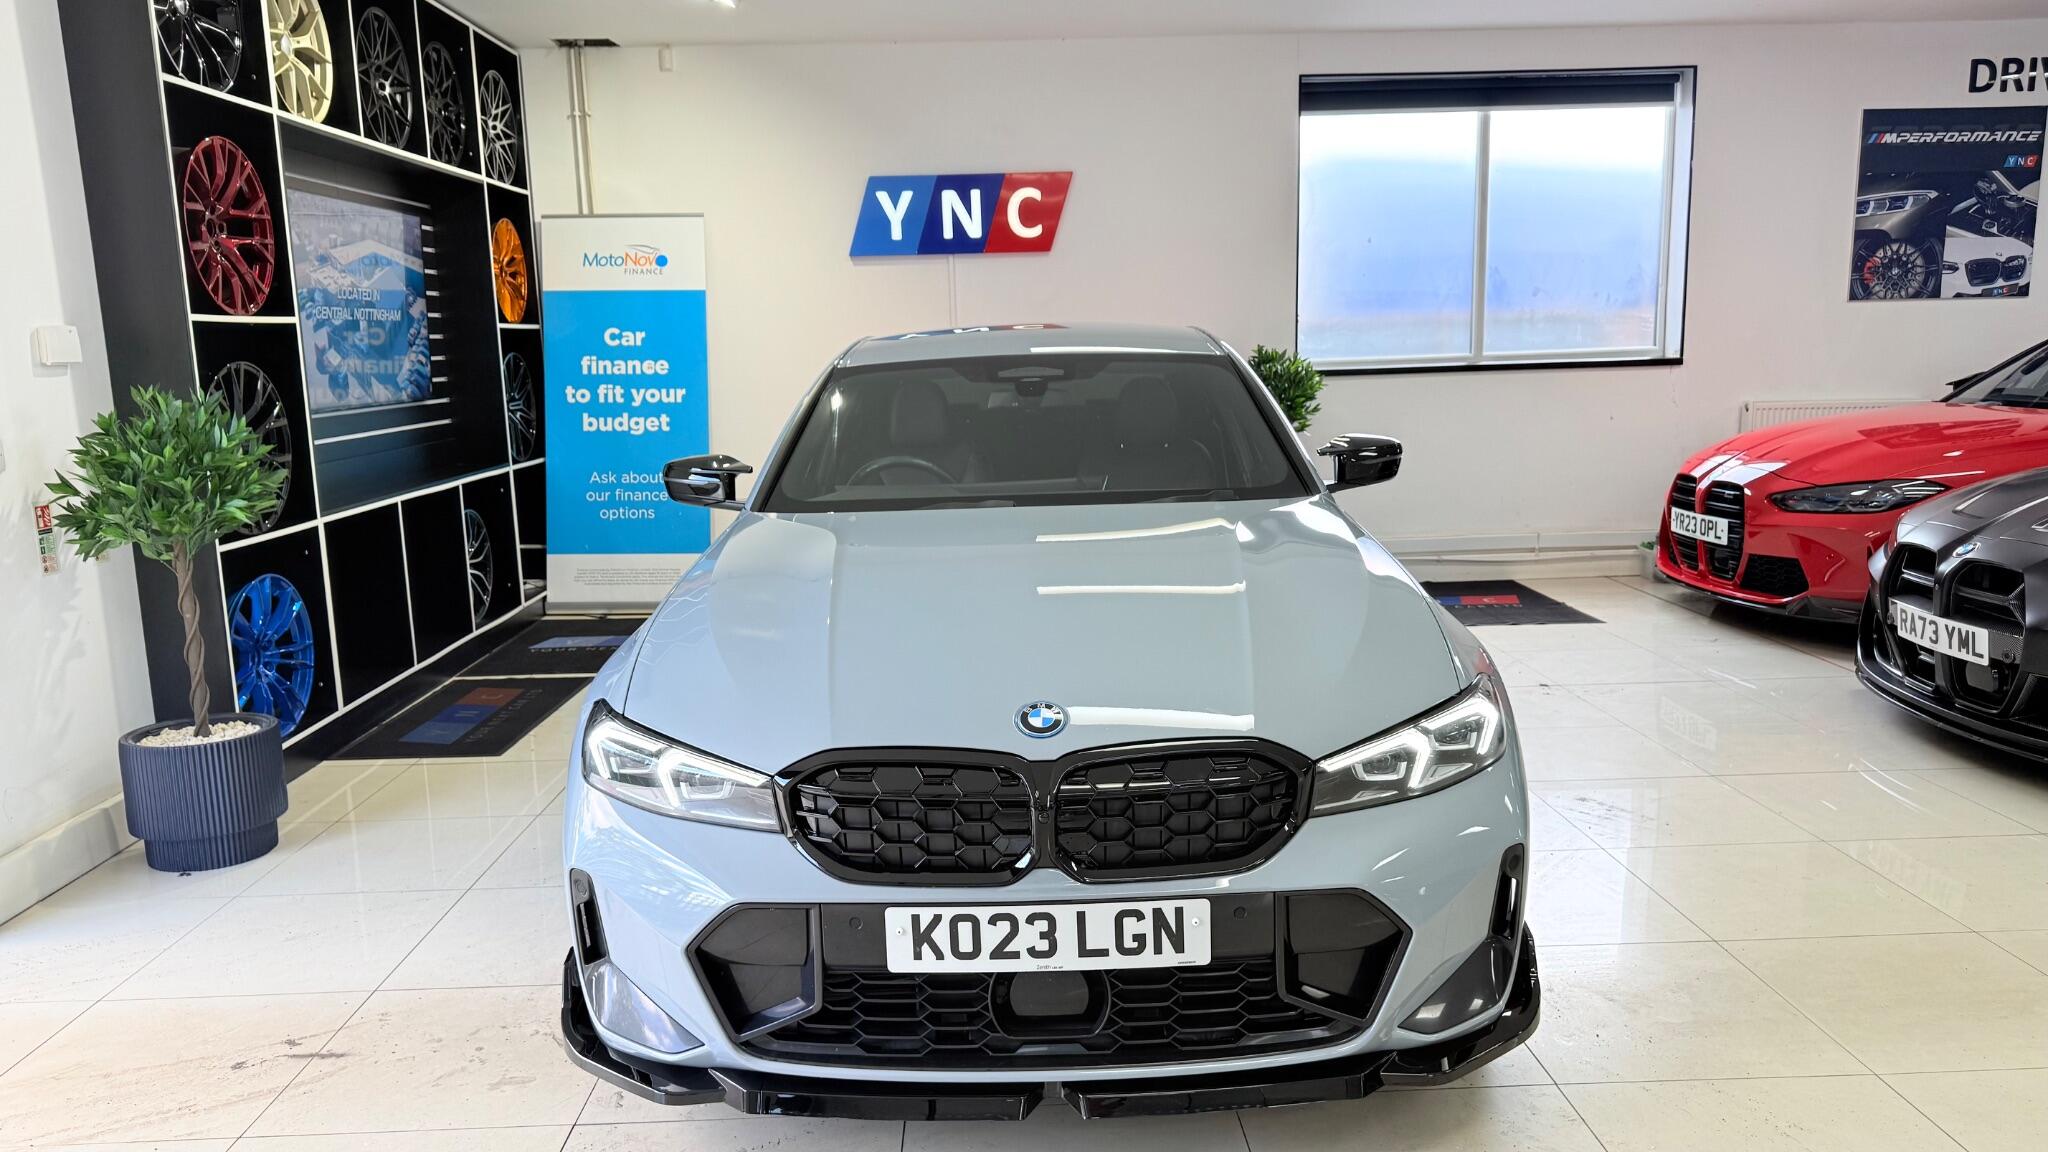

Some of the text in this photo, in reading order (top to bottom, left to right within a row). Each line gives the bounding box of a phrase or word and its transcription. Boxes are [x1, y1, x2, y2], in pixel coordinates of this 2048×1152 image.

[1968, 57, 2048, 93] DRI
[2008, 156, 2035, 166] YNC
[875, 187, 1043, 241] YNC
[624, 268, 664, 276] FINANCE
[337, 287, 372, 301] LOCATED
[315, 306, 402, 322] CENTRAL NOTTINGHAM
[604, 327, 646, 347] Car
[580, 355, 670, 375] finance
[565, 384, 687, 407] to fit your
[582, 412, 671, 436] budget
[589, 471, 664, 484] Ask about
[586, 488, 668, 502] our finance
[600, 506, 656, 521] options
[1674, 511, 1723, 541] YR23 OPL
[1900, 608, 1985, 660] RA73 YML
[910, 905, 1186, 962] KO23 LGN
